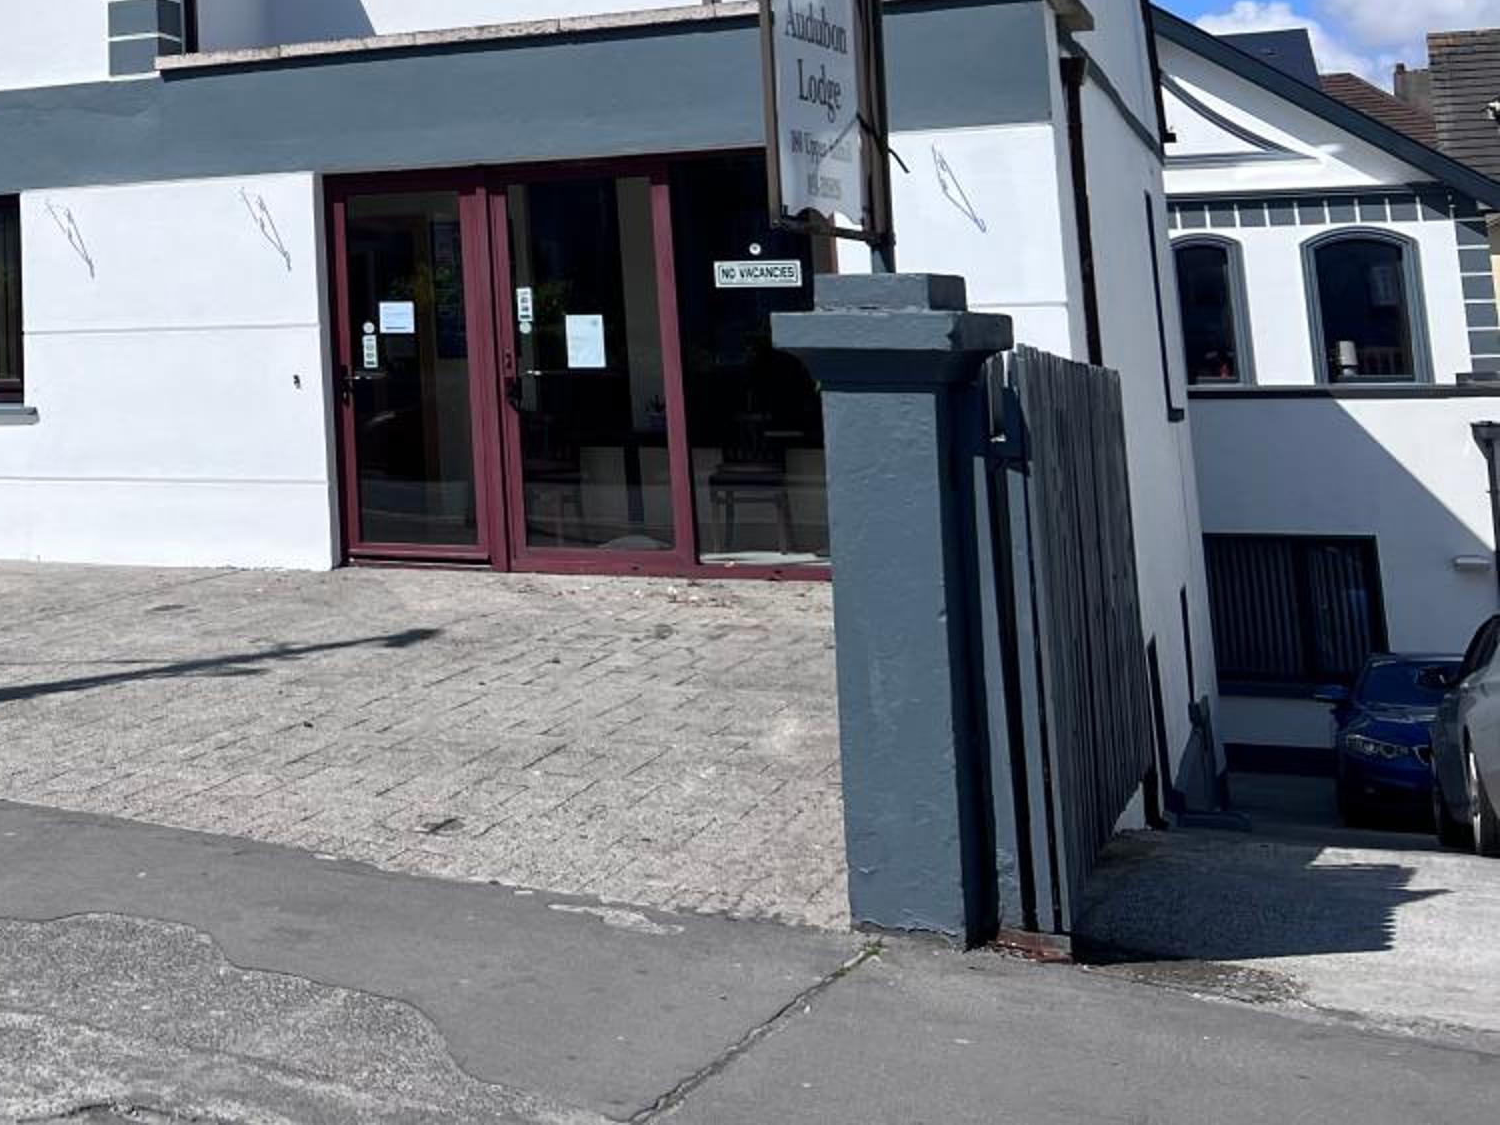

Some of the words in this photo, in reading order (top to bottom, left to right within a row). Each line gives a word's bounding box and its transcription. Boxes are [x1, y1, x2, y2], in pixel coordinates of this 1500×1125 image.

[798, 58, 841, 123] Lodge
[721, 267, 736, 280] NO
[740, 266, 795, 279] VACANCIES
